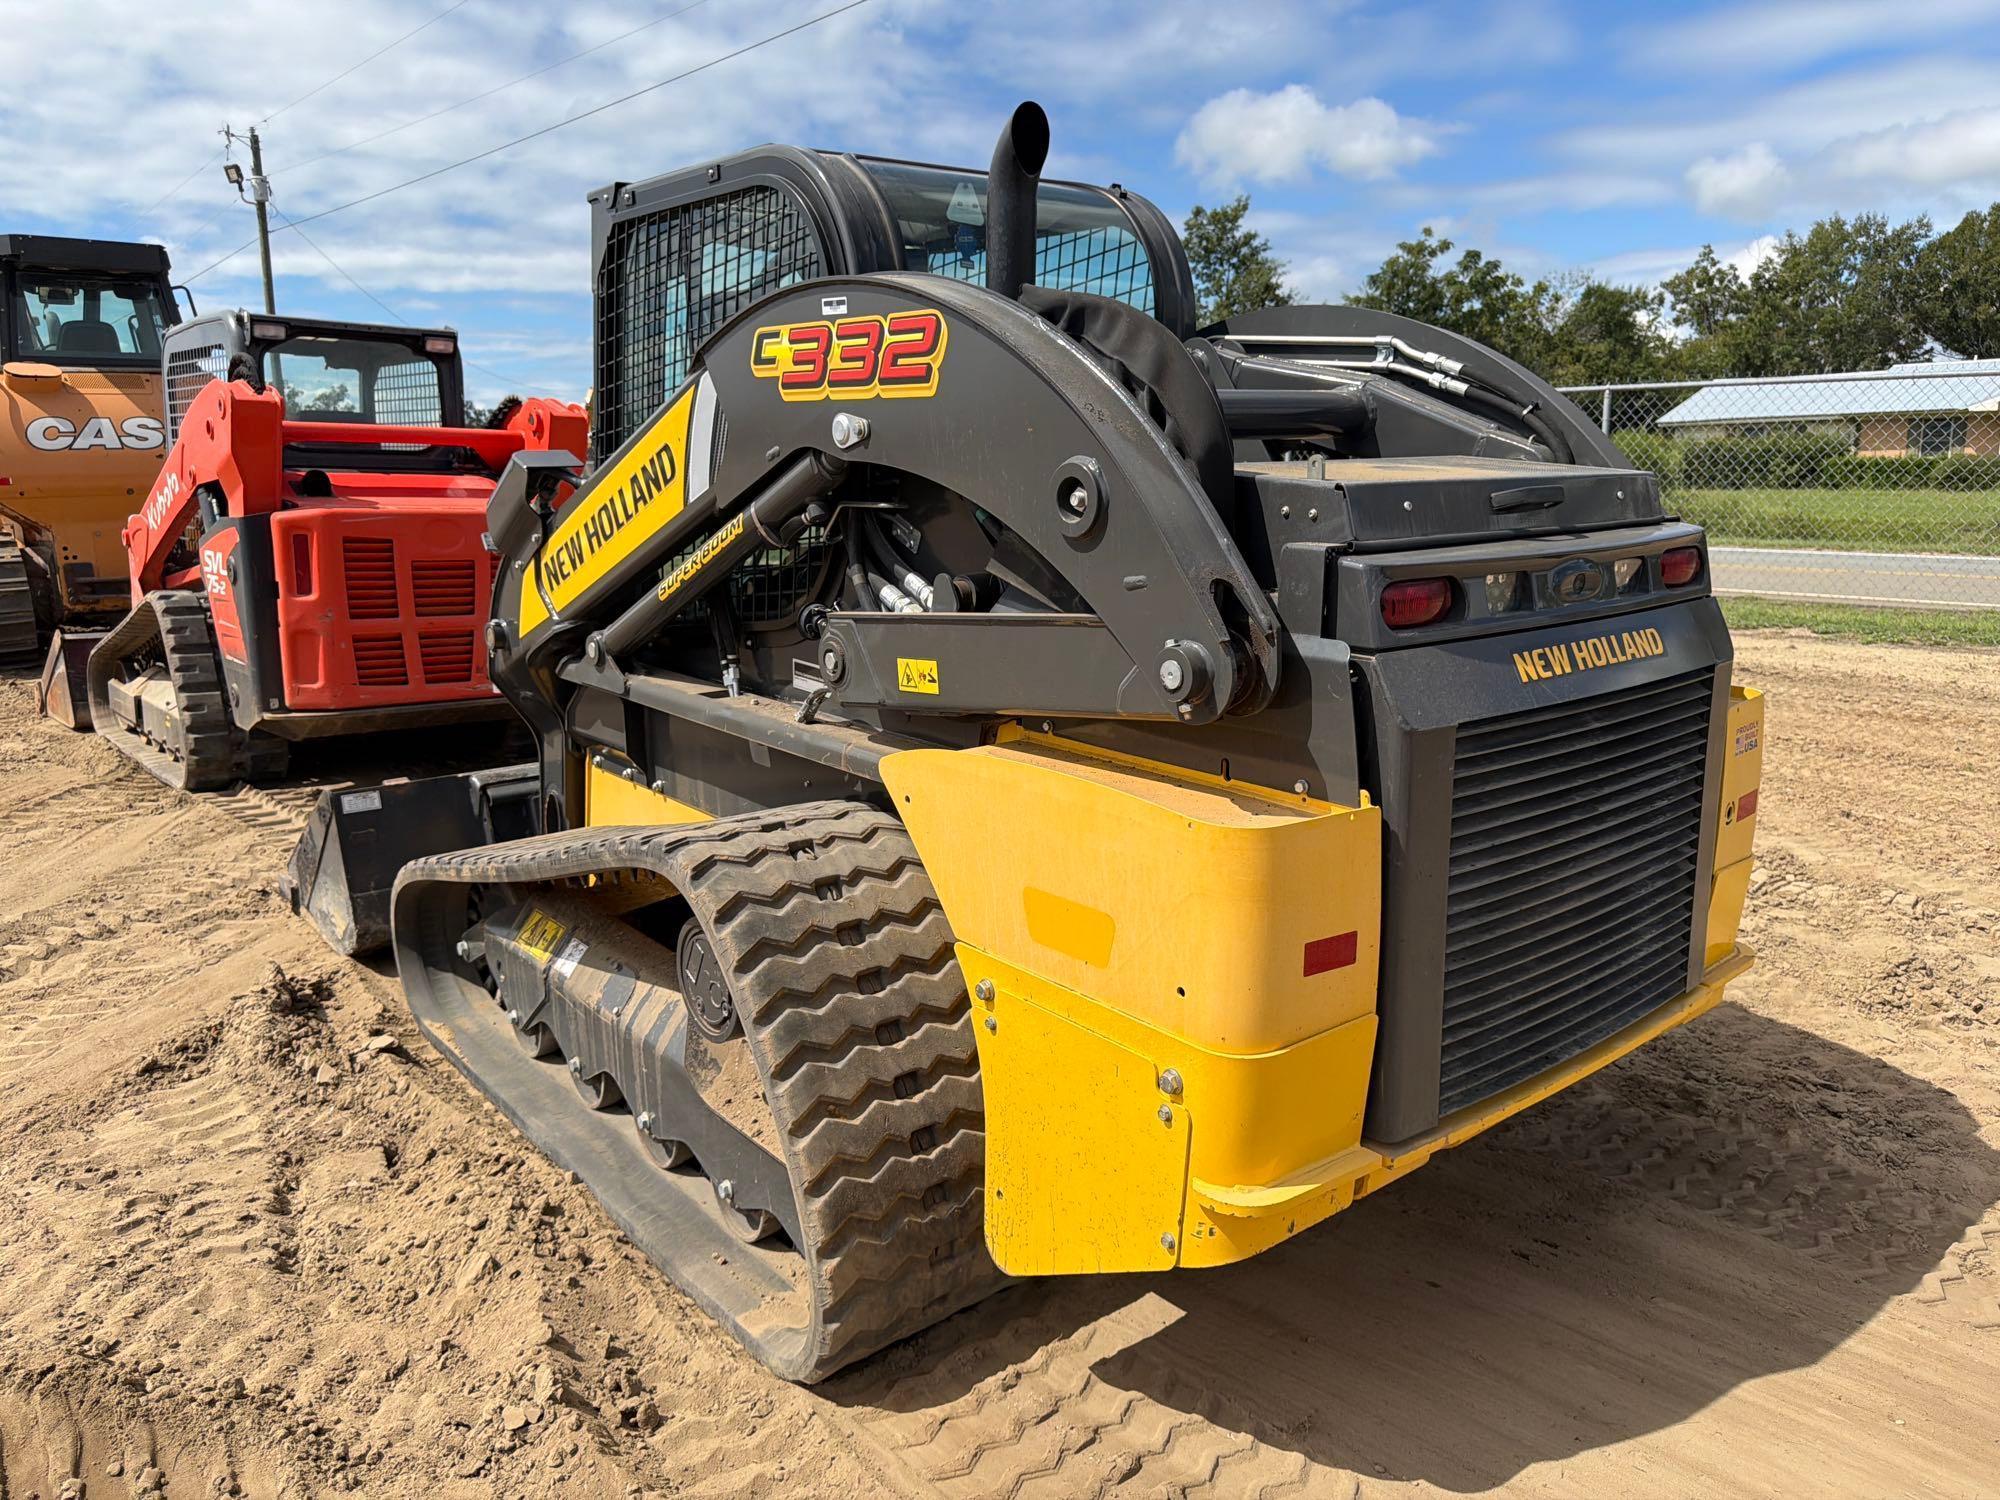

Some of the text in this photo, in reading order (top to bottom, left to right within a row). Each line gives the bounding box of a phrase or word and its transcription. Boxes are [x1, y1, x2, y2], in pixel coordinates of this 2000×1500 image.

[752, 310, 948, 401] C332
[25, 416, 166, 451] CAS
[147, 472, 180, 530] Kubota
[543, 442, 677, 593] NEW HOLLAND
[203, 550, 228, 576] SVL
[206, 574, 227, 596] 75-2
[658, 512, 743, 602] SUPER BOOM
[1512, 627, 1664, 684] NEW HOLLAND
